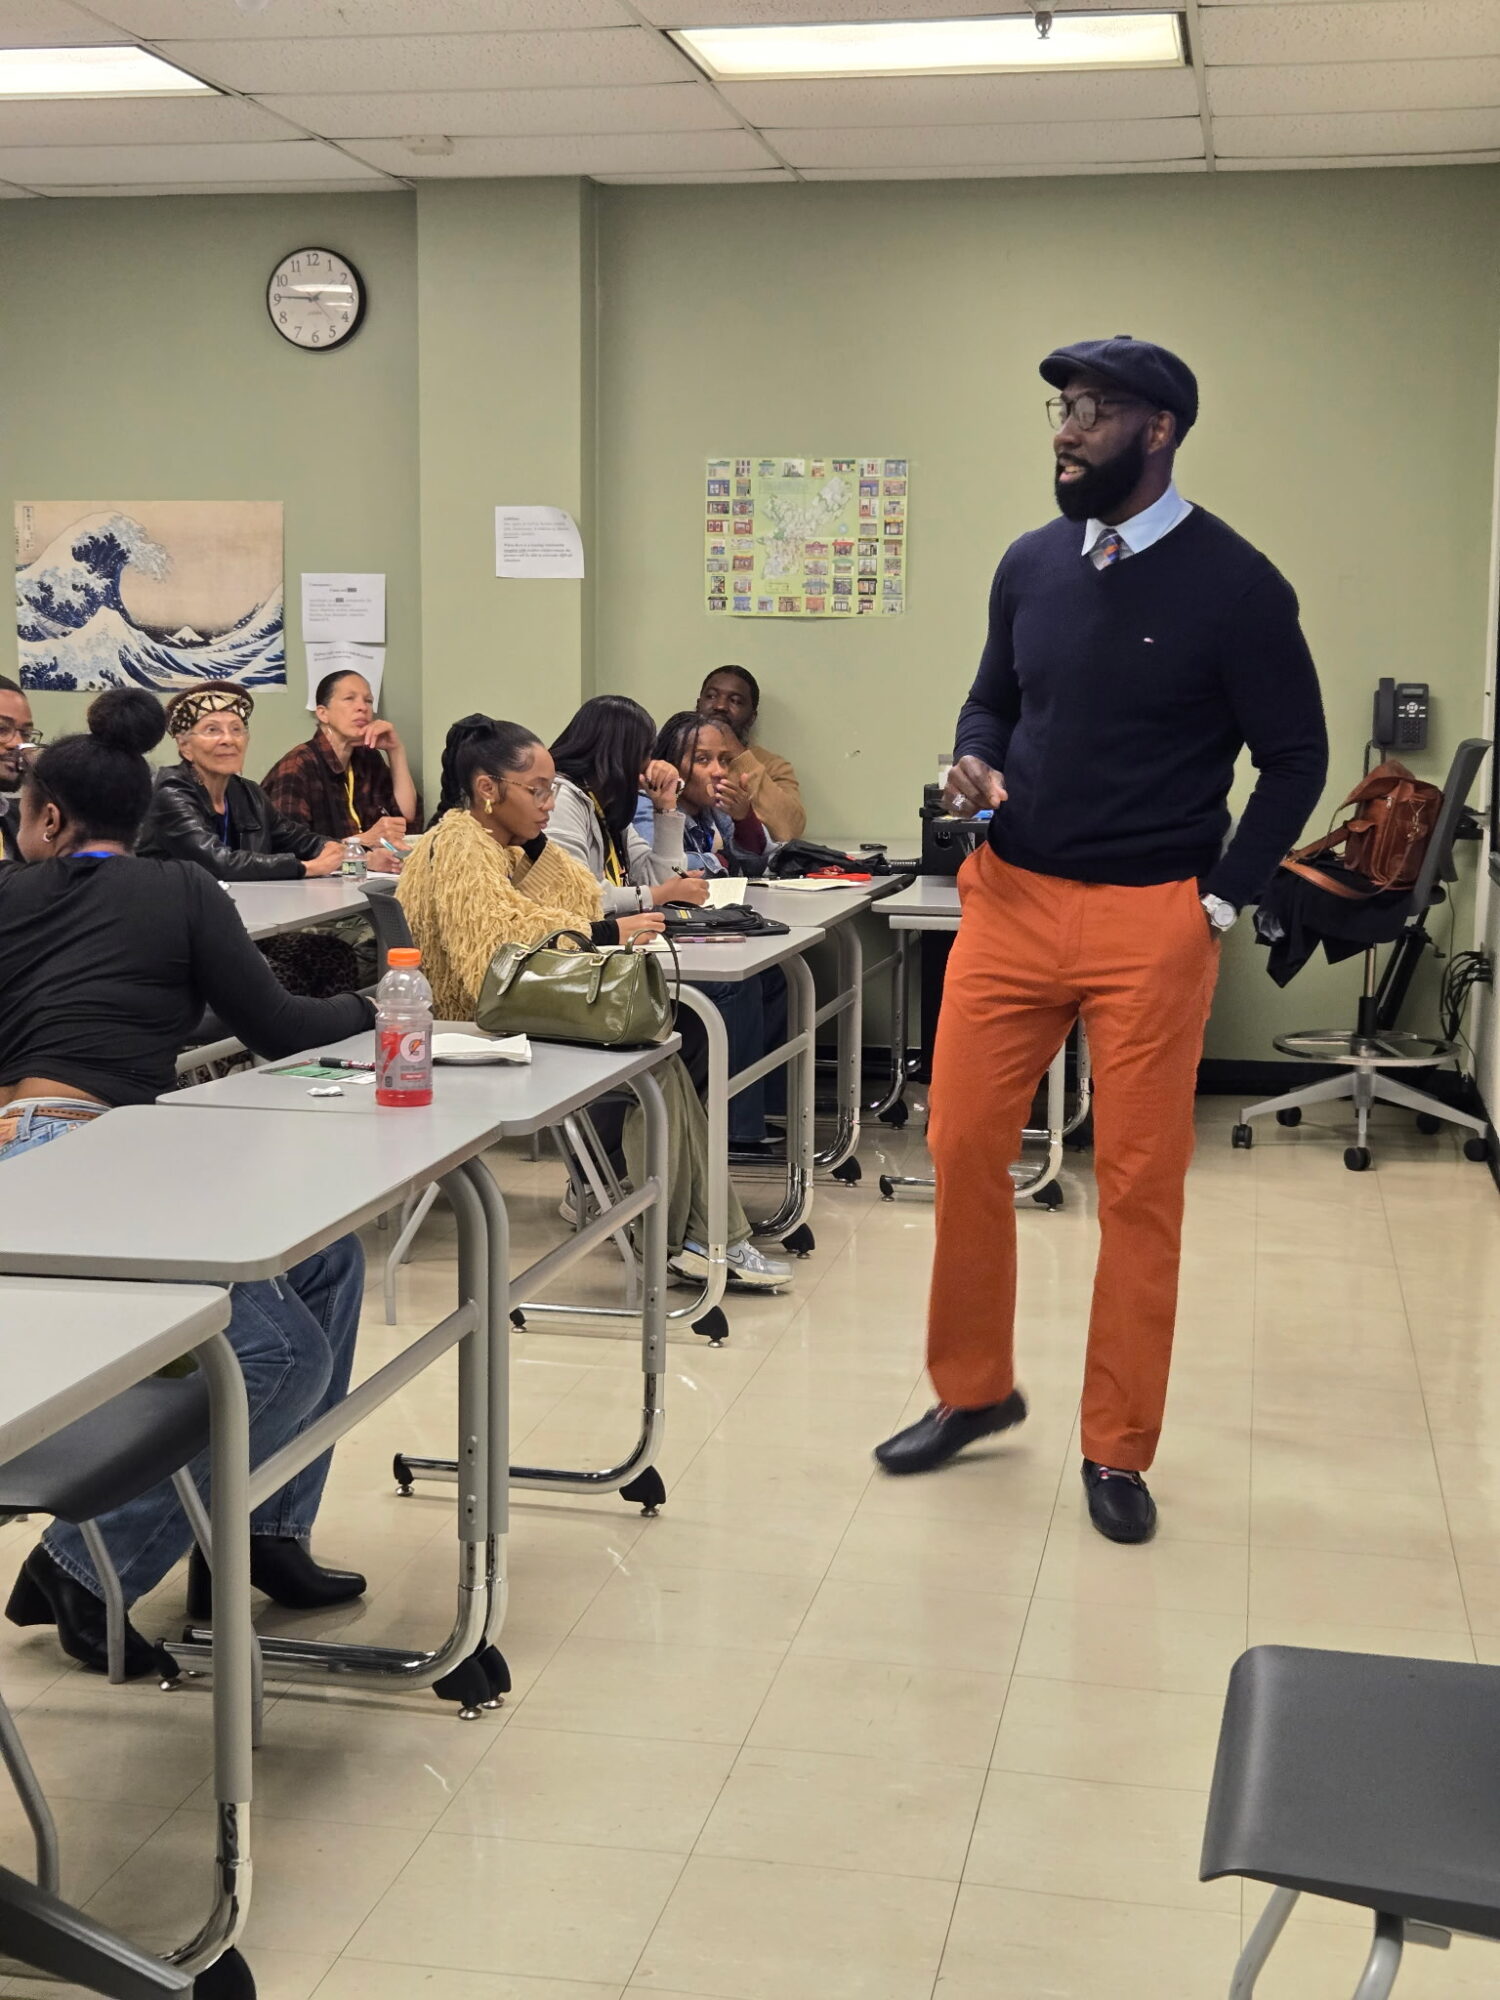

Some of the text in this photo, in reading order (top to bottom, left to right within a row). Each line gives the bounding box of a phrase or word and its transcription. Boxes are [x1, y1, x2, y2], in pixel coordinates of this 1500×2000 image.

[291, 260, 300, 272] 11
[306, 253, 320, 266] 12
[276, 274, 288, 287] 10
[340, 272, 348, 285] 2
[274, 293, 282, 306] 9
[279, 311, 288, 324] 8
[342, 311, 350, 322] 4
[294, 326, 302, 338] 7
[312, 330, 320, 343] 6
[328, 325, 336, 338] 5
[400, 1031, 425, 1062] G
